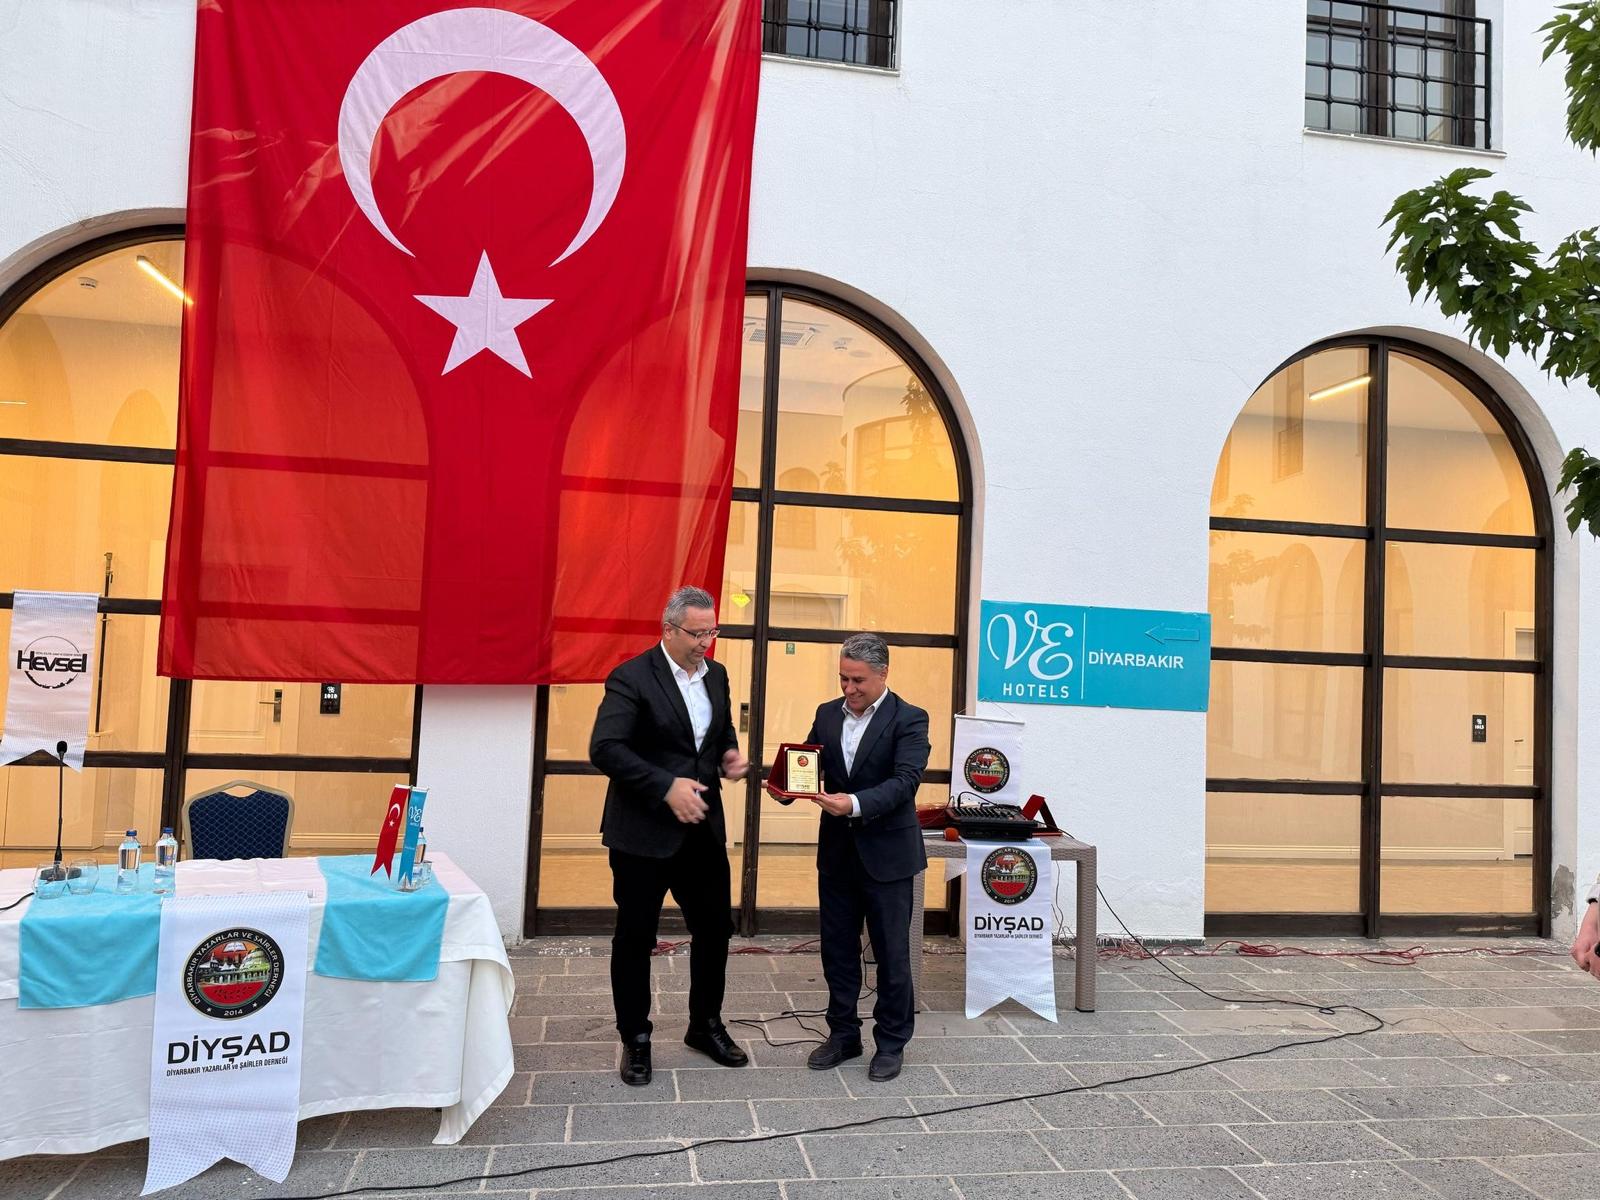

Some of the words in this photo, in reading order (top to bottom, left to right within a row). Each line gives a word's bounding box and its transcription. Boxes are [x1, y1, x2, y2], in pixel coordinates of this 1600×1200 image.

[17, 650, 88, 673] Hevsel
[1088, 648, 1185, 669] DİYARBAKIR
[1002, 683, 1070, 699] HOTELS
[974, 912, 1044, 934] DİYŞAD
[197, 931, 240, 957] YAZARLAR
[241, 931, 254, 940] VE
[223, 1008, 244, 1017] 2014
[167, 1031, 291, 1065] DİYŞAD
[166, 1066, 201, 1077] DİYARBAKIR
[202, 1063, 231, 1073] YAZARLAR
[239, 1058, 263, 1071] ŞAİRLER
[264, 1056, 289, 1066] DERNEĞİ
